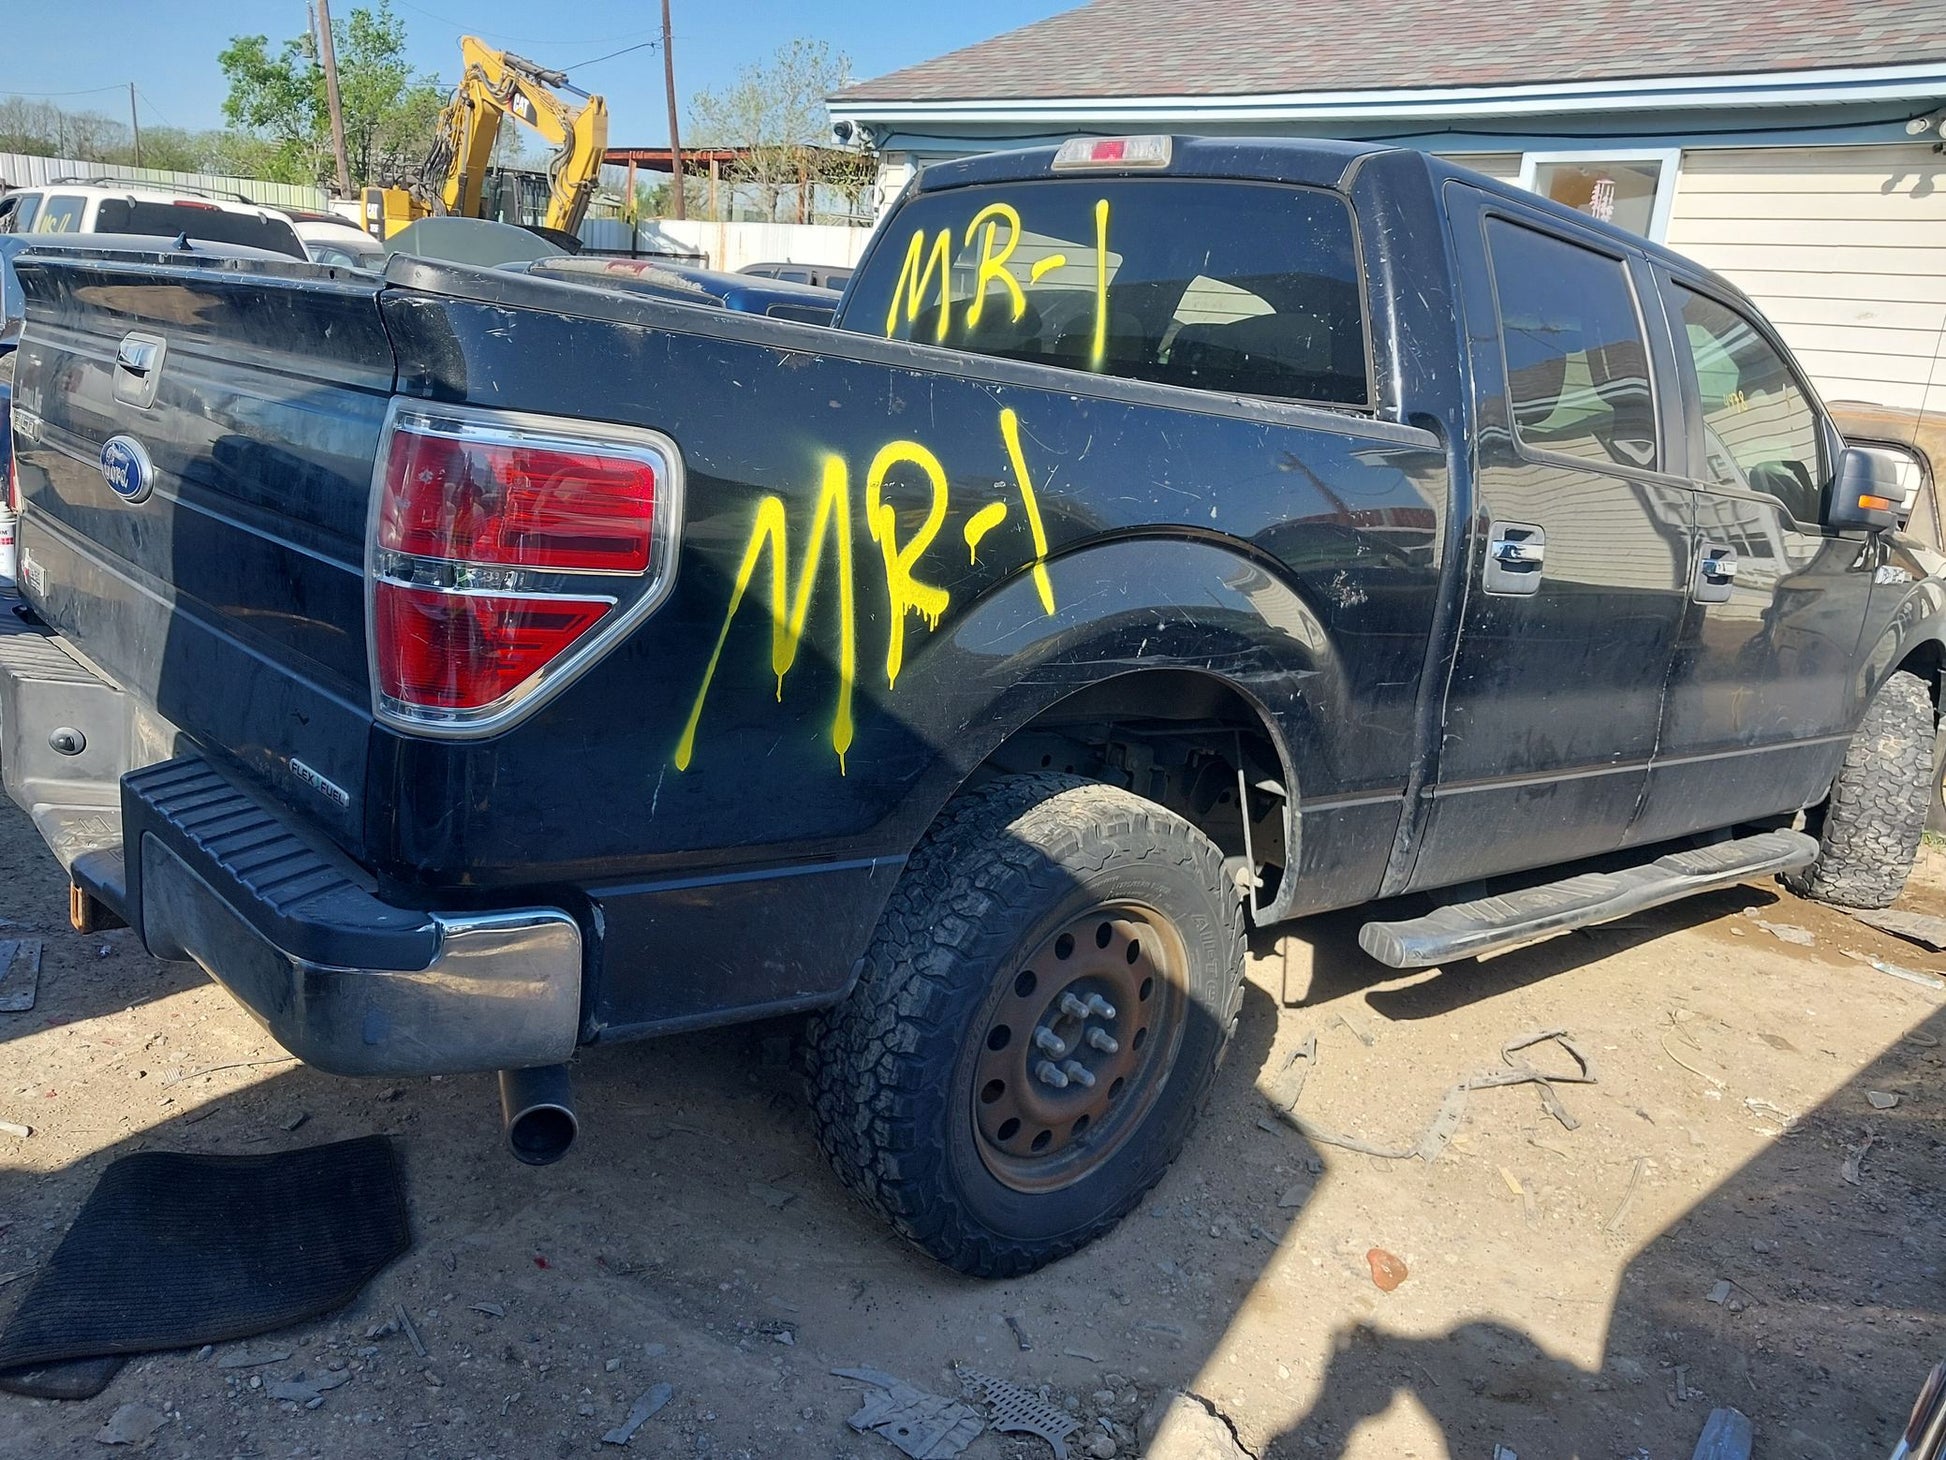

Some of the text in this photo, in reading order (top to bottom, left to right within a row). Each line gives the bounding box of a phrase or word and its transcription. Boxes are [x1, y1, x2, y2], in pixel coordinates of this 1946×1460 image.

[513, 92, 530, 118] CAT
[886, 199, 1109, 372] MR-1
[103, 461, 130, 489] Ford
[675, 408, 1056, 777] MR-1
[291, 761, 345, 806] FLEX FUEL
